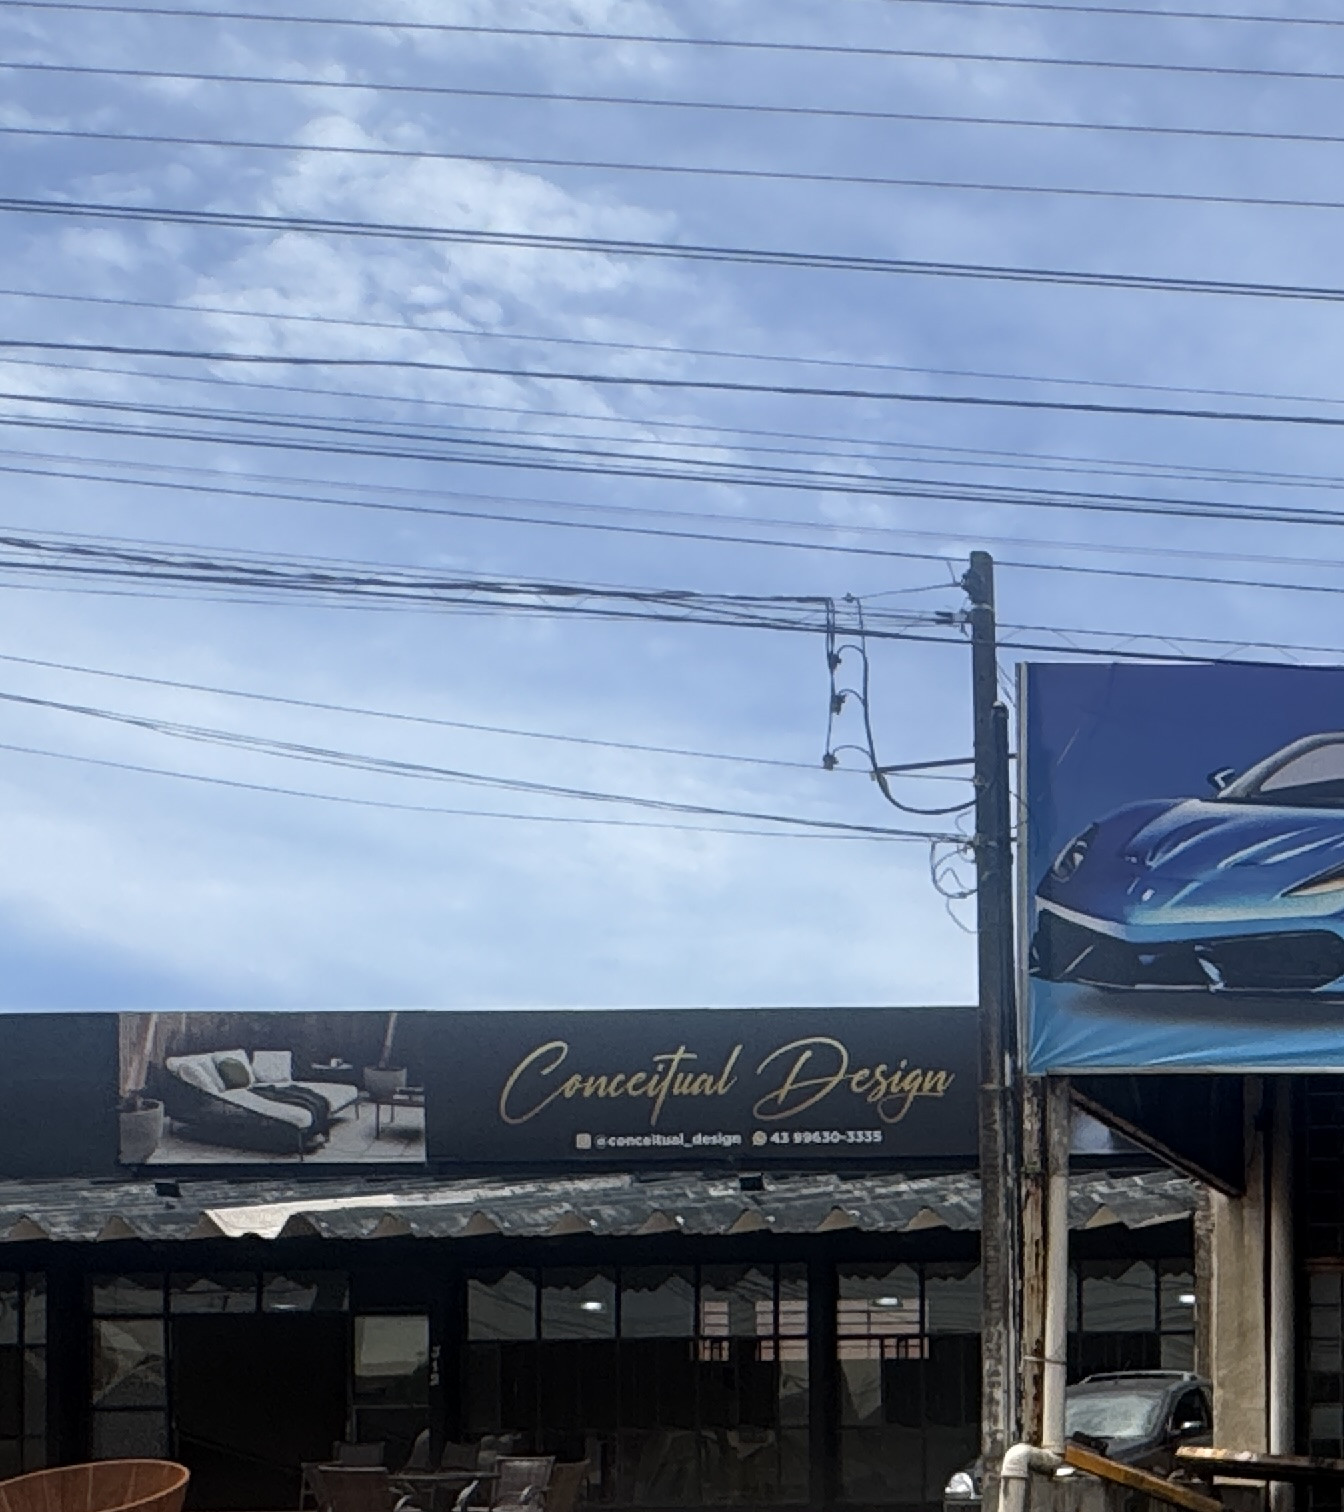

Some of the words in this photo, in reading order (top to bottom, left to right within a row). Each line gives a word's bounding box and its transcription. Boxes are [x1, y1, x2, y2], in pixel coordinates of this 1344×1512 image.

[500, 1040, 745, 1126] Conceitual
[752, 1036, 955, 1123] Design
[596, 1132, 741, 1148] @conceitual_design
[770, 1132, 790, 1144] 43
